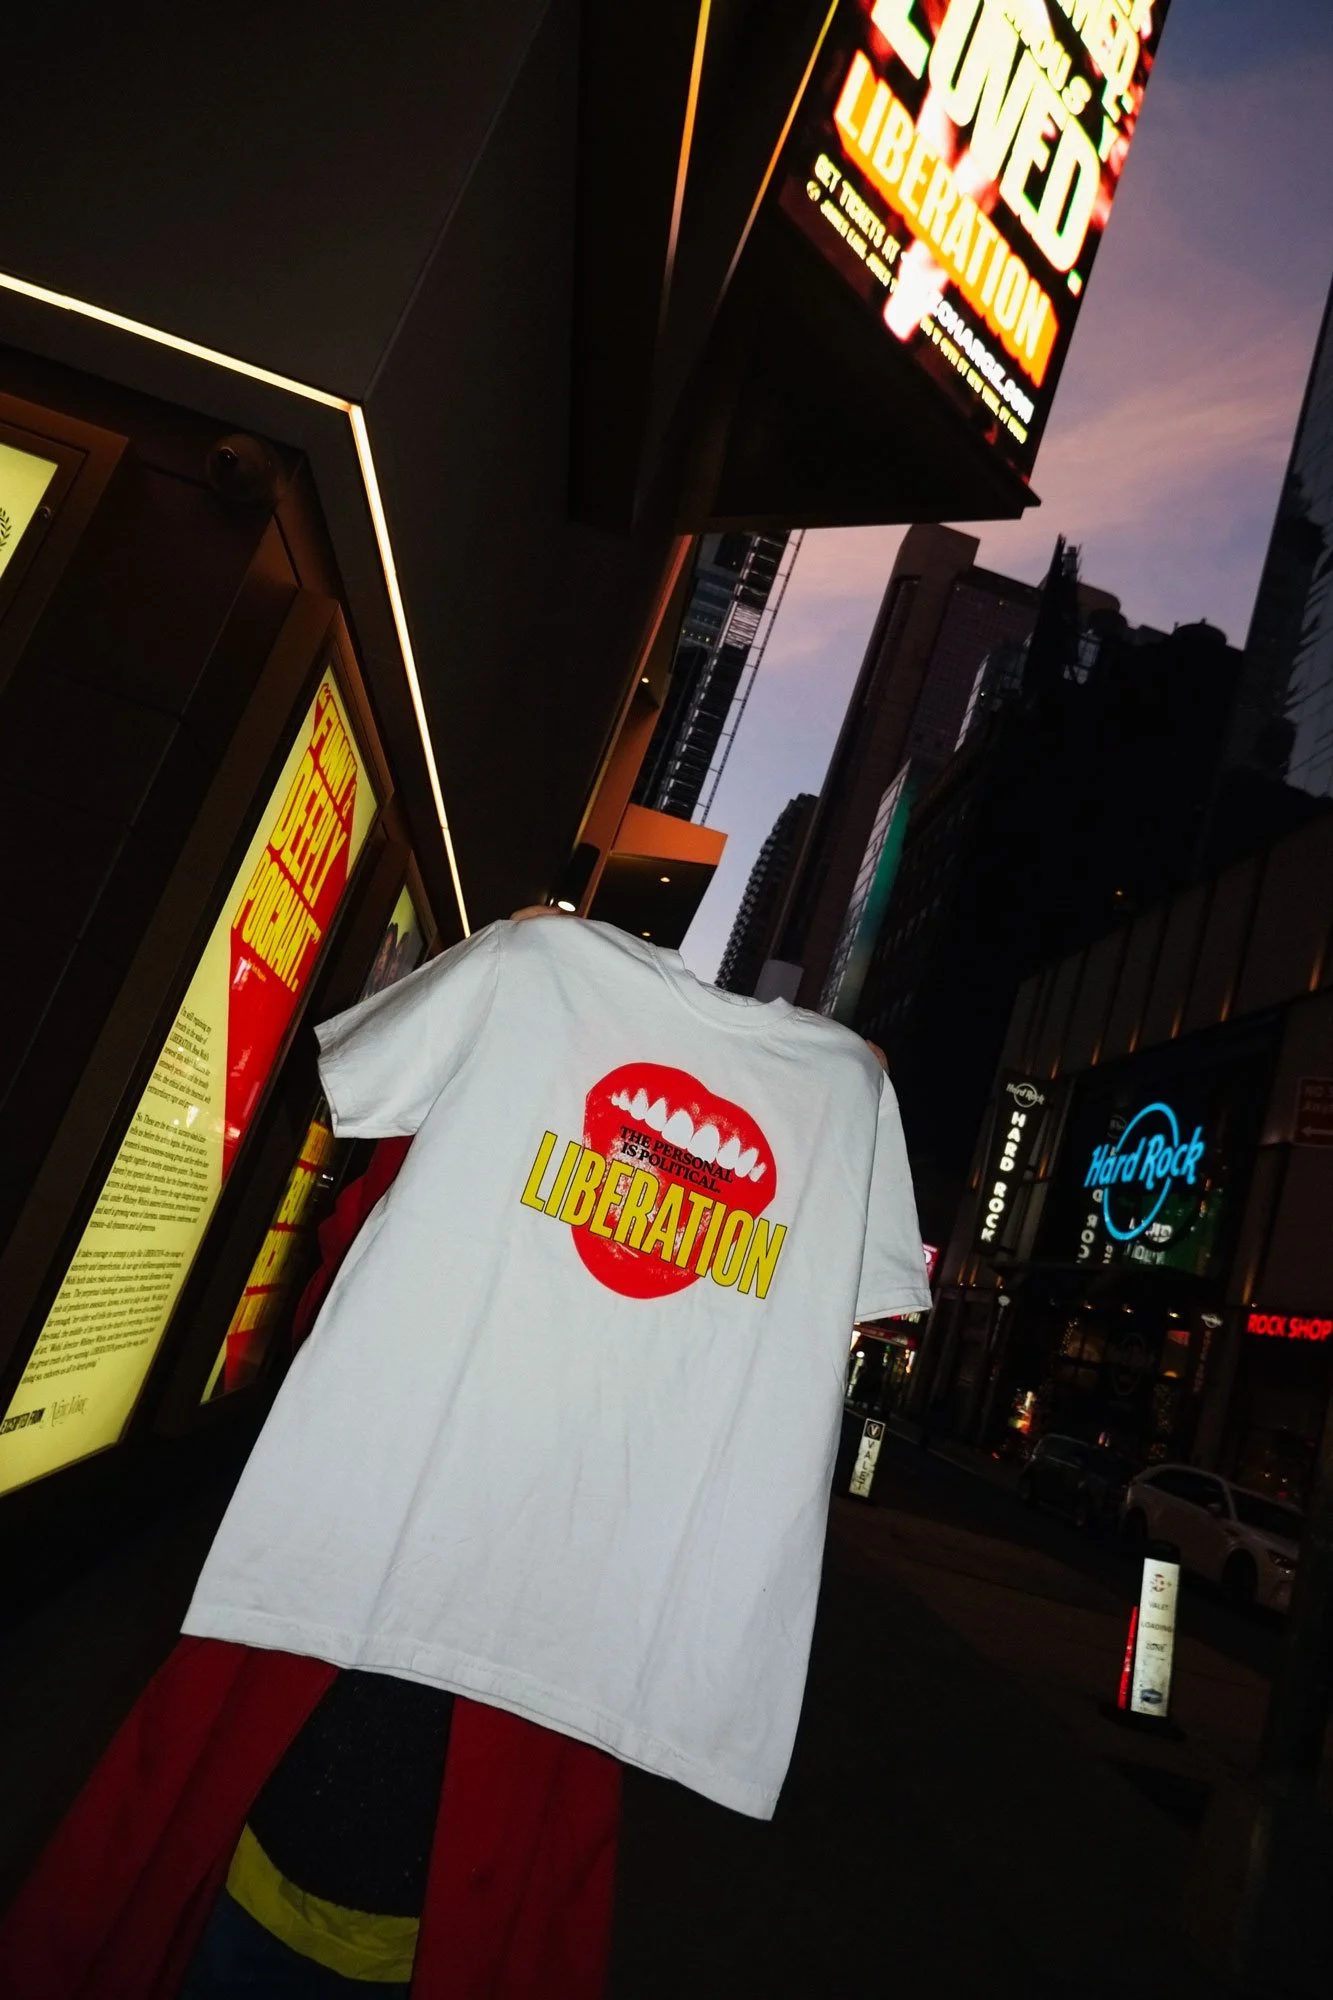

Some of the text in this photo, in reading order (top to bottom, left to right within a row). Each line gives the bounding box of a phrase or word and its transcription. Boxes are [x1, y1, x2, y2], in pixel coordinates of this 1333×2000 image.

[815, 153, 842, 193] GET
[839, 180, 887, 249] TICKETS
[881, 234, 901, 265] AT
[834, 49, 1058, 387] LIBERATION
[269, 748, 348, 910] DEEPLY
[620, 1125, 734, 1184] THE PERSONAL
[620, 1141, 722, 1194] IS POLITICAL.
[981, 1111, 1027, 1243] HARD ROCK
[1083, 1124, 1206, 1190] Hard Rock
[519, 1129, 788, 1300] LIBERATION
[1247, 1314, 1288, 1337] ROCK
[1289, 1316, 1333, 1341] SHOP
[856, 1439, 876, 1491] VALET
[1140, 1621, 1174, 1634] LOADING
